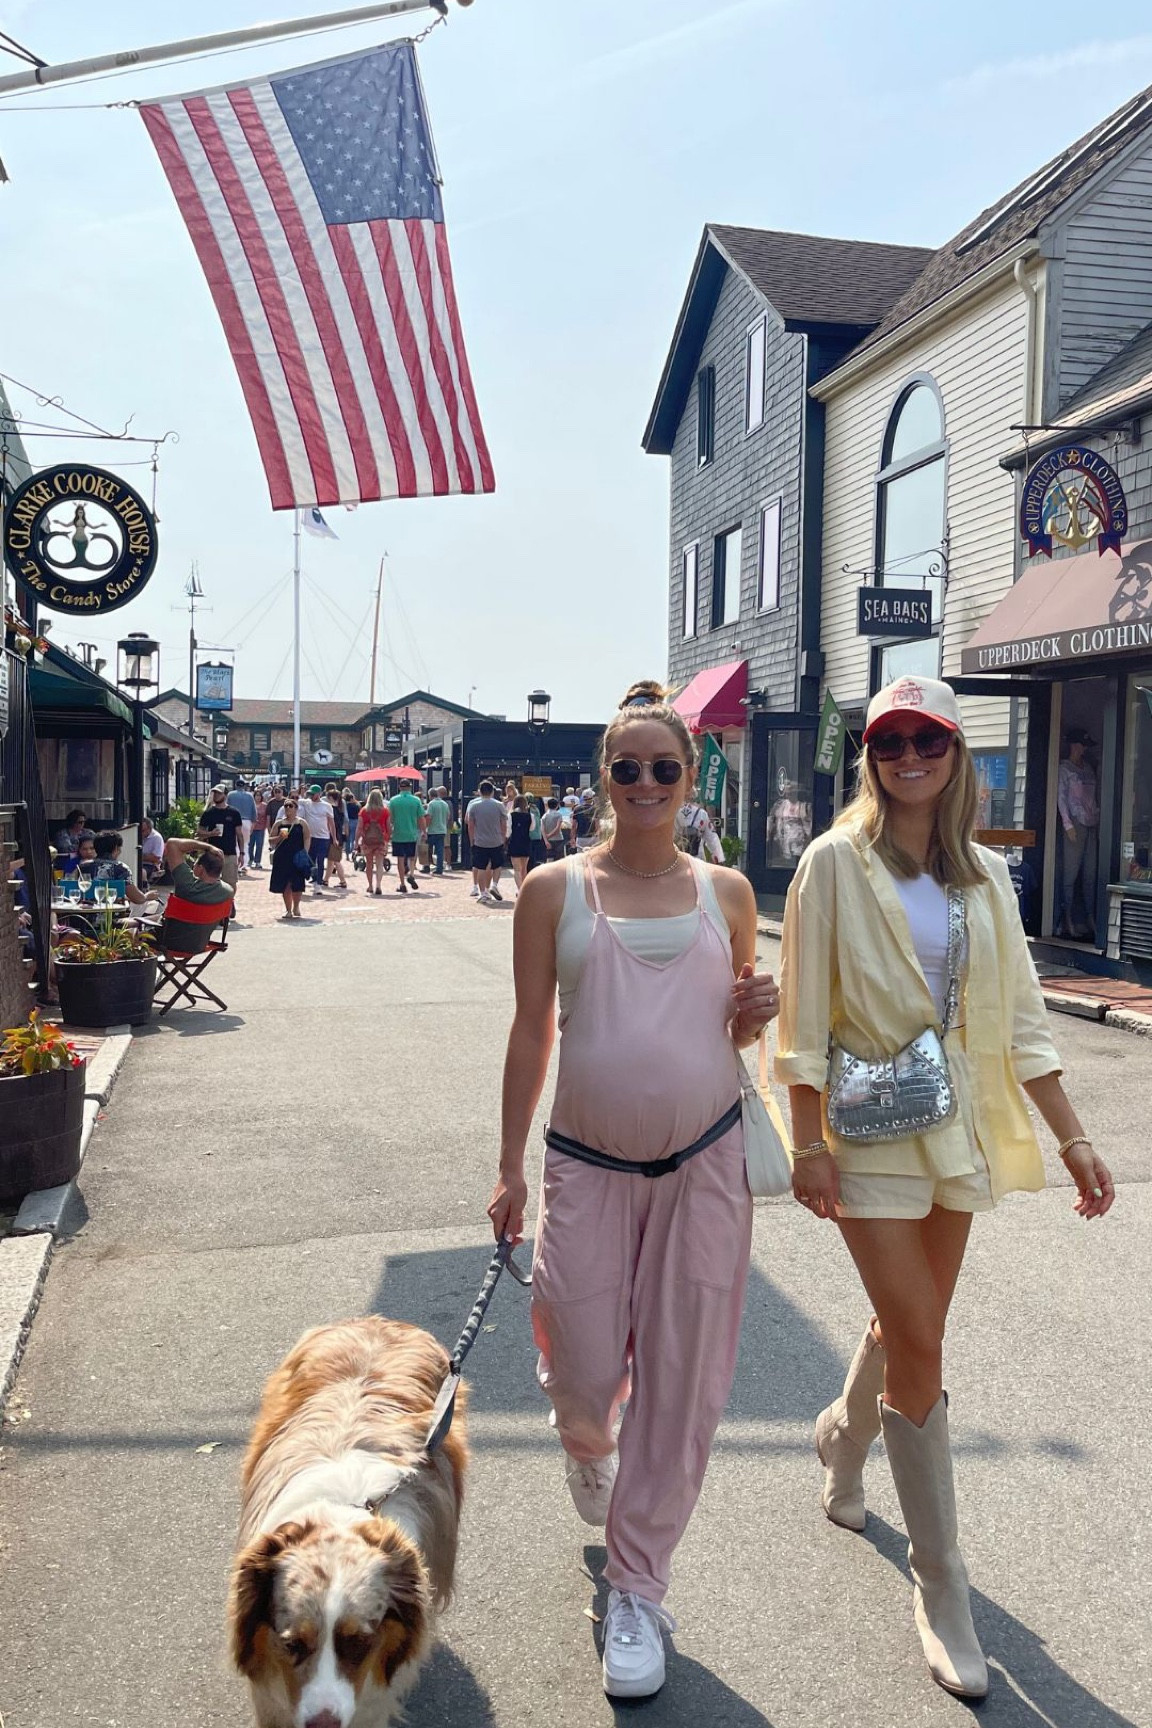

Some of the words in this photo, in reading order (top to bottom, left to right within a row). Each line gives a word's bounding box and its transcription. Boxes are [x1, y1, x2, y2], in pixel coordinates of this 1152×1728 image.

[1025, 452, 1068, 521] UPPERDECK
[1082, 452, 1125, 518] CLOTHING
[9, 480, 55, 549] CLARKE
[54, 472, 120, 502] COOKE
[114, 495, 150, 556] HOUSE
[21, 560, 47, 591] The
[51, 585, 101, 608] Candy
[106, 567, 141, 600] Store
[864, 599, 889, 622] SEA
[893, 600, 928, 624] BAGS
[978, 637, 1061, 668] UPPERDECK
[1070, 622, 1152, 654] CLOTHIN
[817, 713, 841, 770] OPEN
[704, 754, 721, 801] OPEN
